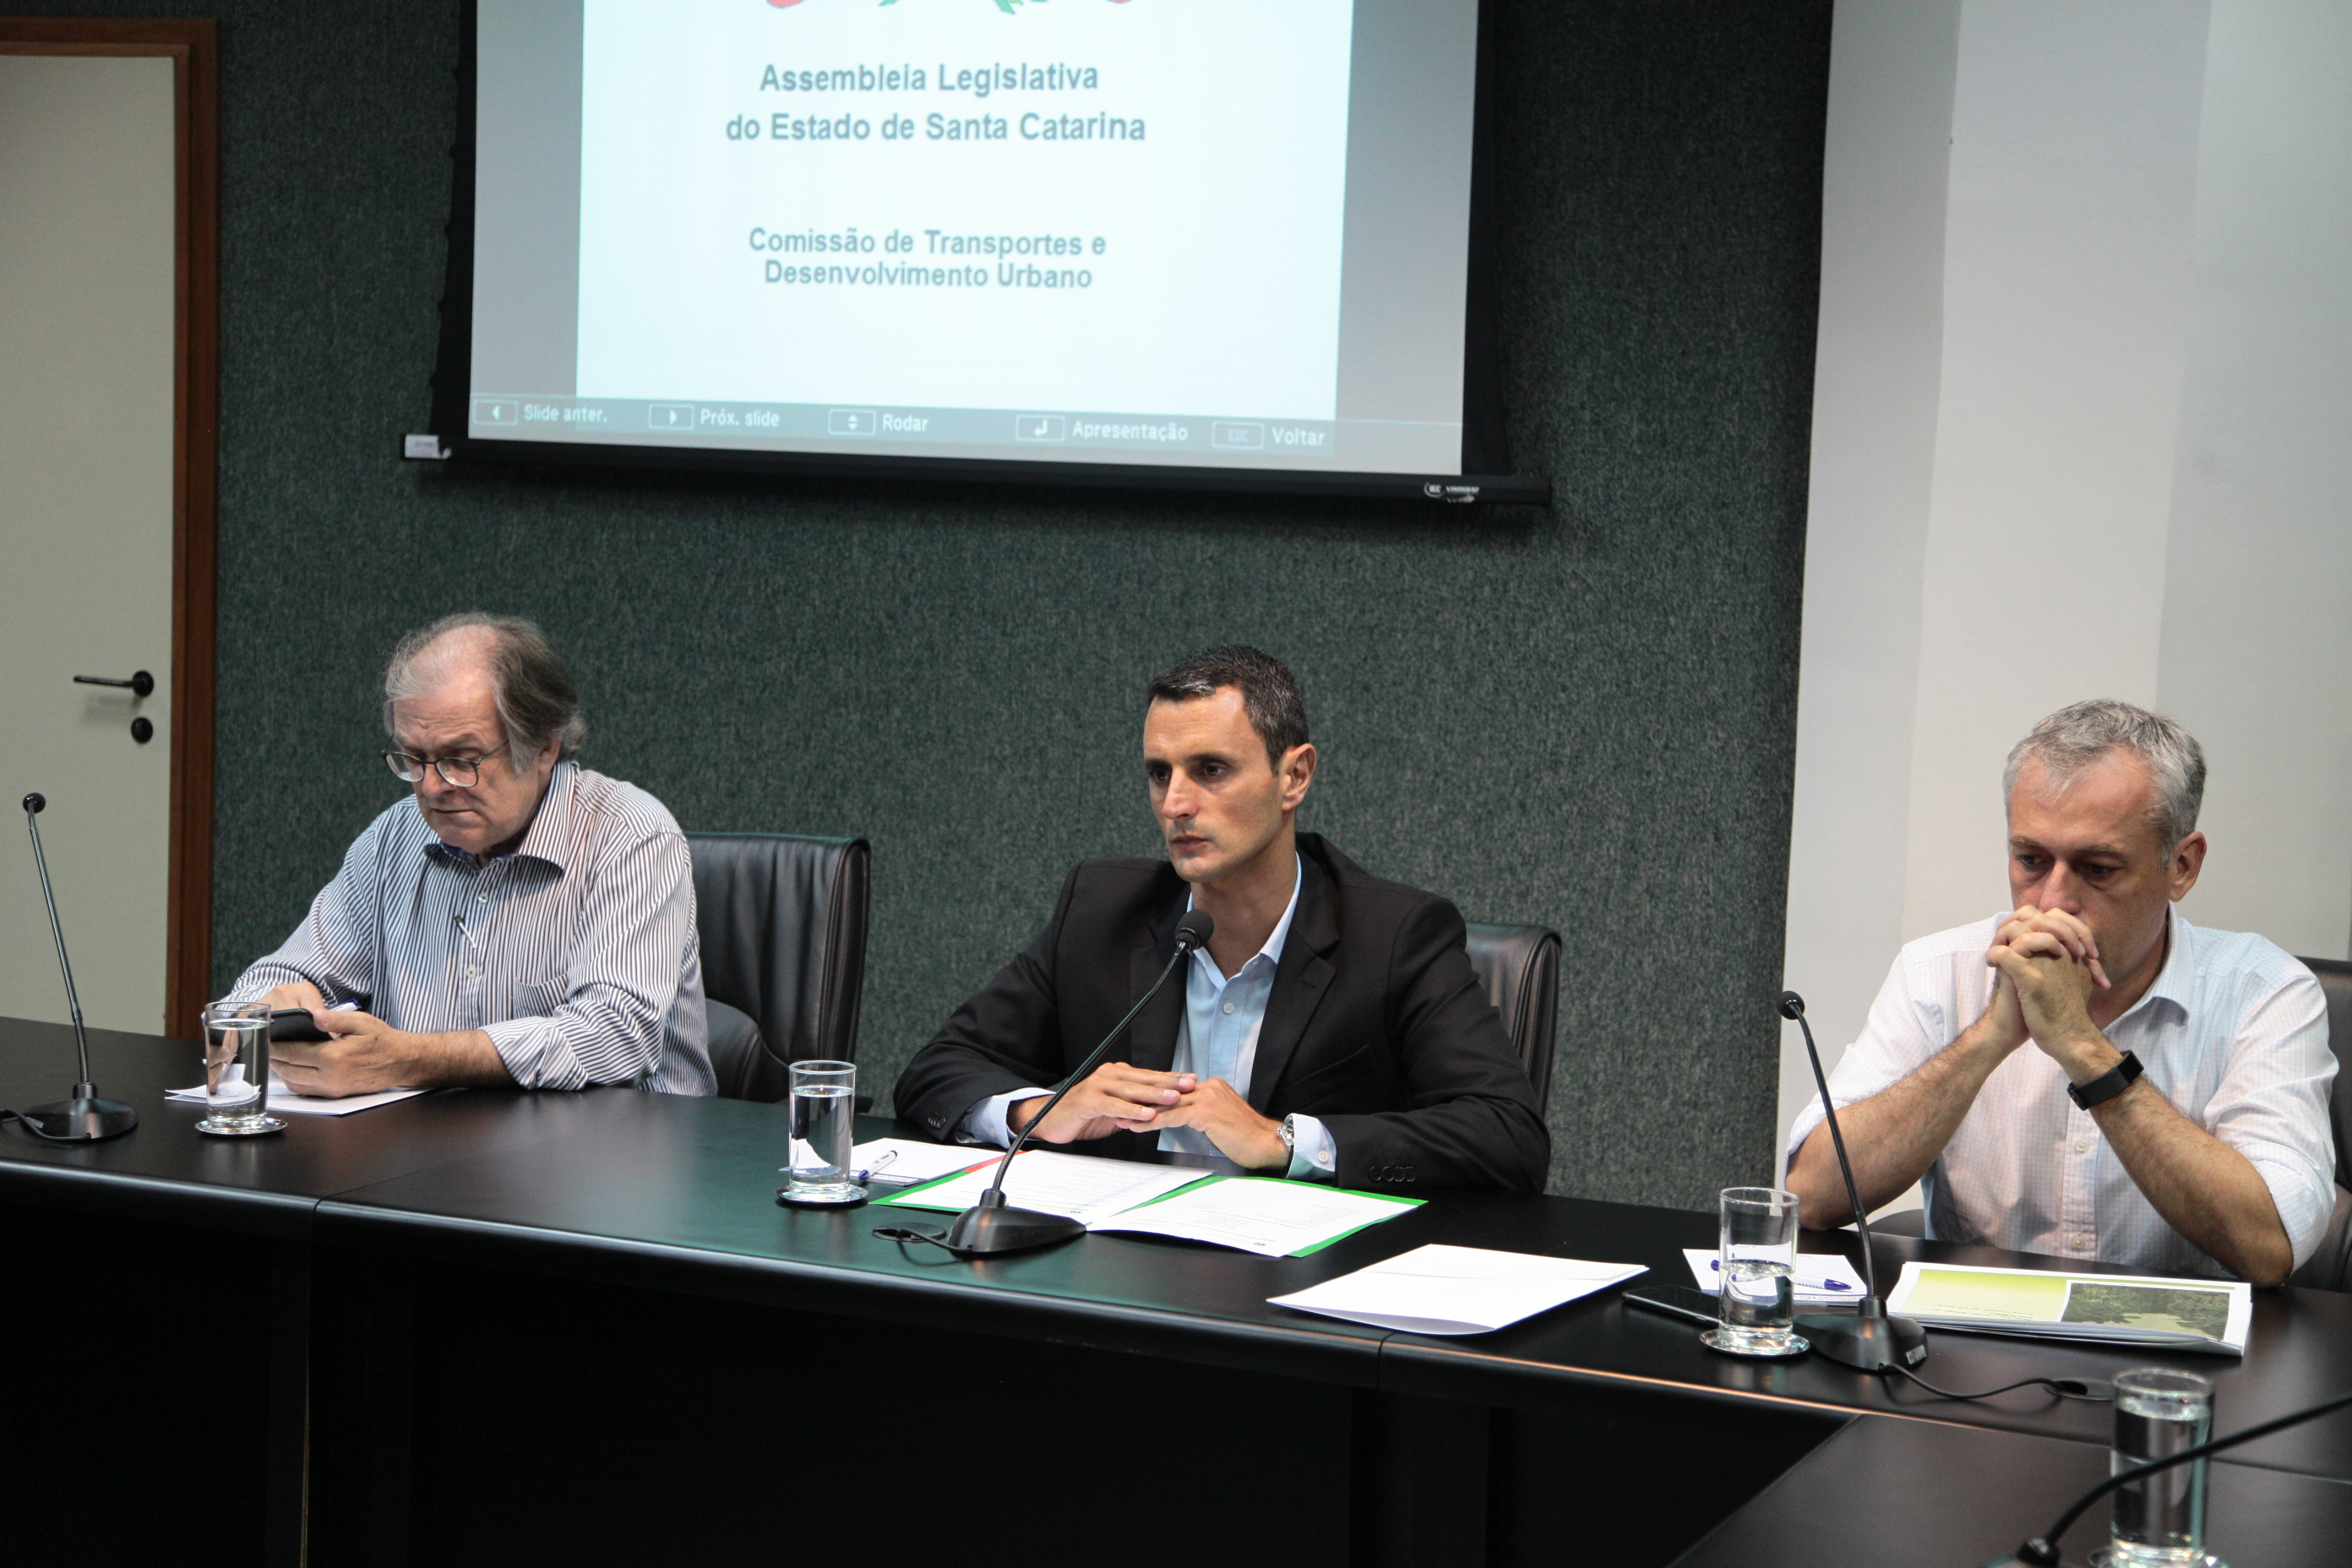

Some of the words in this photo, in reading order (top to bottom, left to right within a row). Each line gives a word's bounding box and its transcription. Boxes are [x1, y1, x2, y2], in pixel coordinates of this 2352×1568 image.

[760, 63, 927, 92] Assembleia
[938, 62, 1099, 98] Legislativa
[726, 115, 760, 140] do
[770, 112, 871, 140] Estado
[881, 113, 915, 139] de
[925, 112, 1009, 141] Santa
[1019, 112, 1146, 140] Catarina
[749, 227, 876, 253] Comissão
[884, 229, 914, 253] de
[925, 230, 1082, 259] Transportes
[1092, 237, 1107, 254] e
[765, 259, 988, 287] Desenvolvimento
[998, 263, 1093, 288] Urbano
[524, 404, 558, 422] Slide
[563, 407, 608, 423] anter.
[700, 408, 740, 427] Próx.
[745, 411, 780, 428] slide
[882, 414, 929, 432] Rodar
[1072, 420, 1189, 442] Apresentação
[1272, 427, 1326, 447] Voltar
